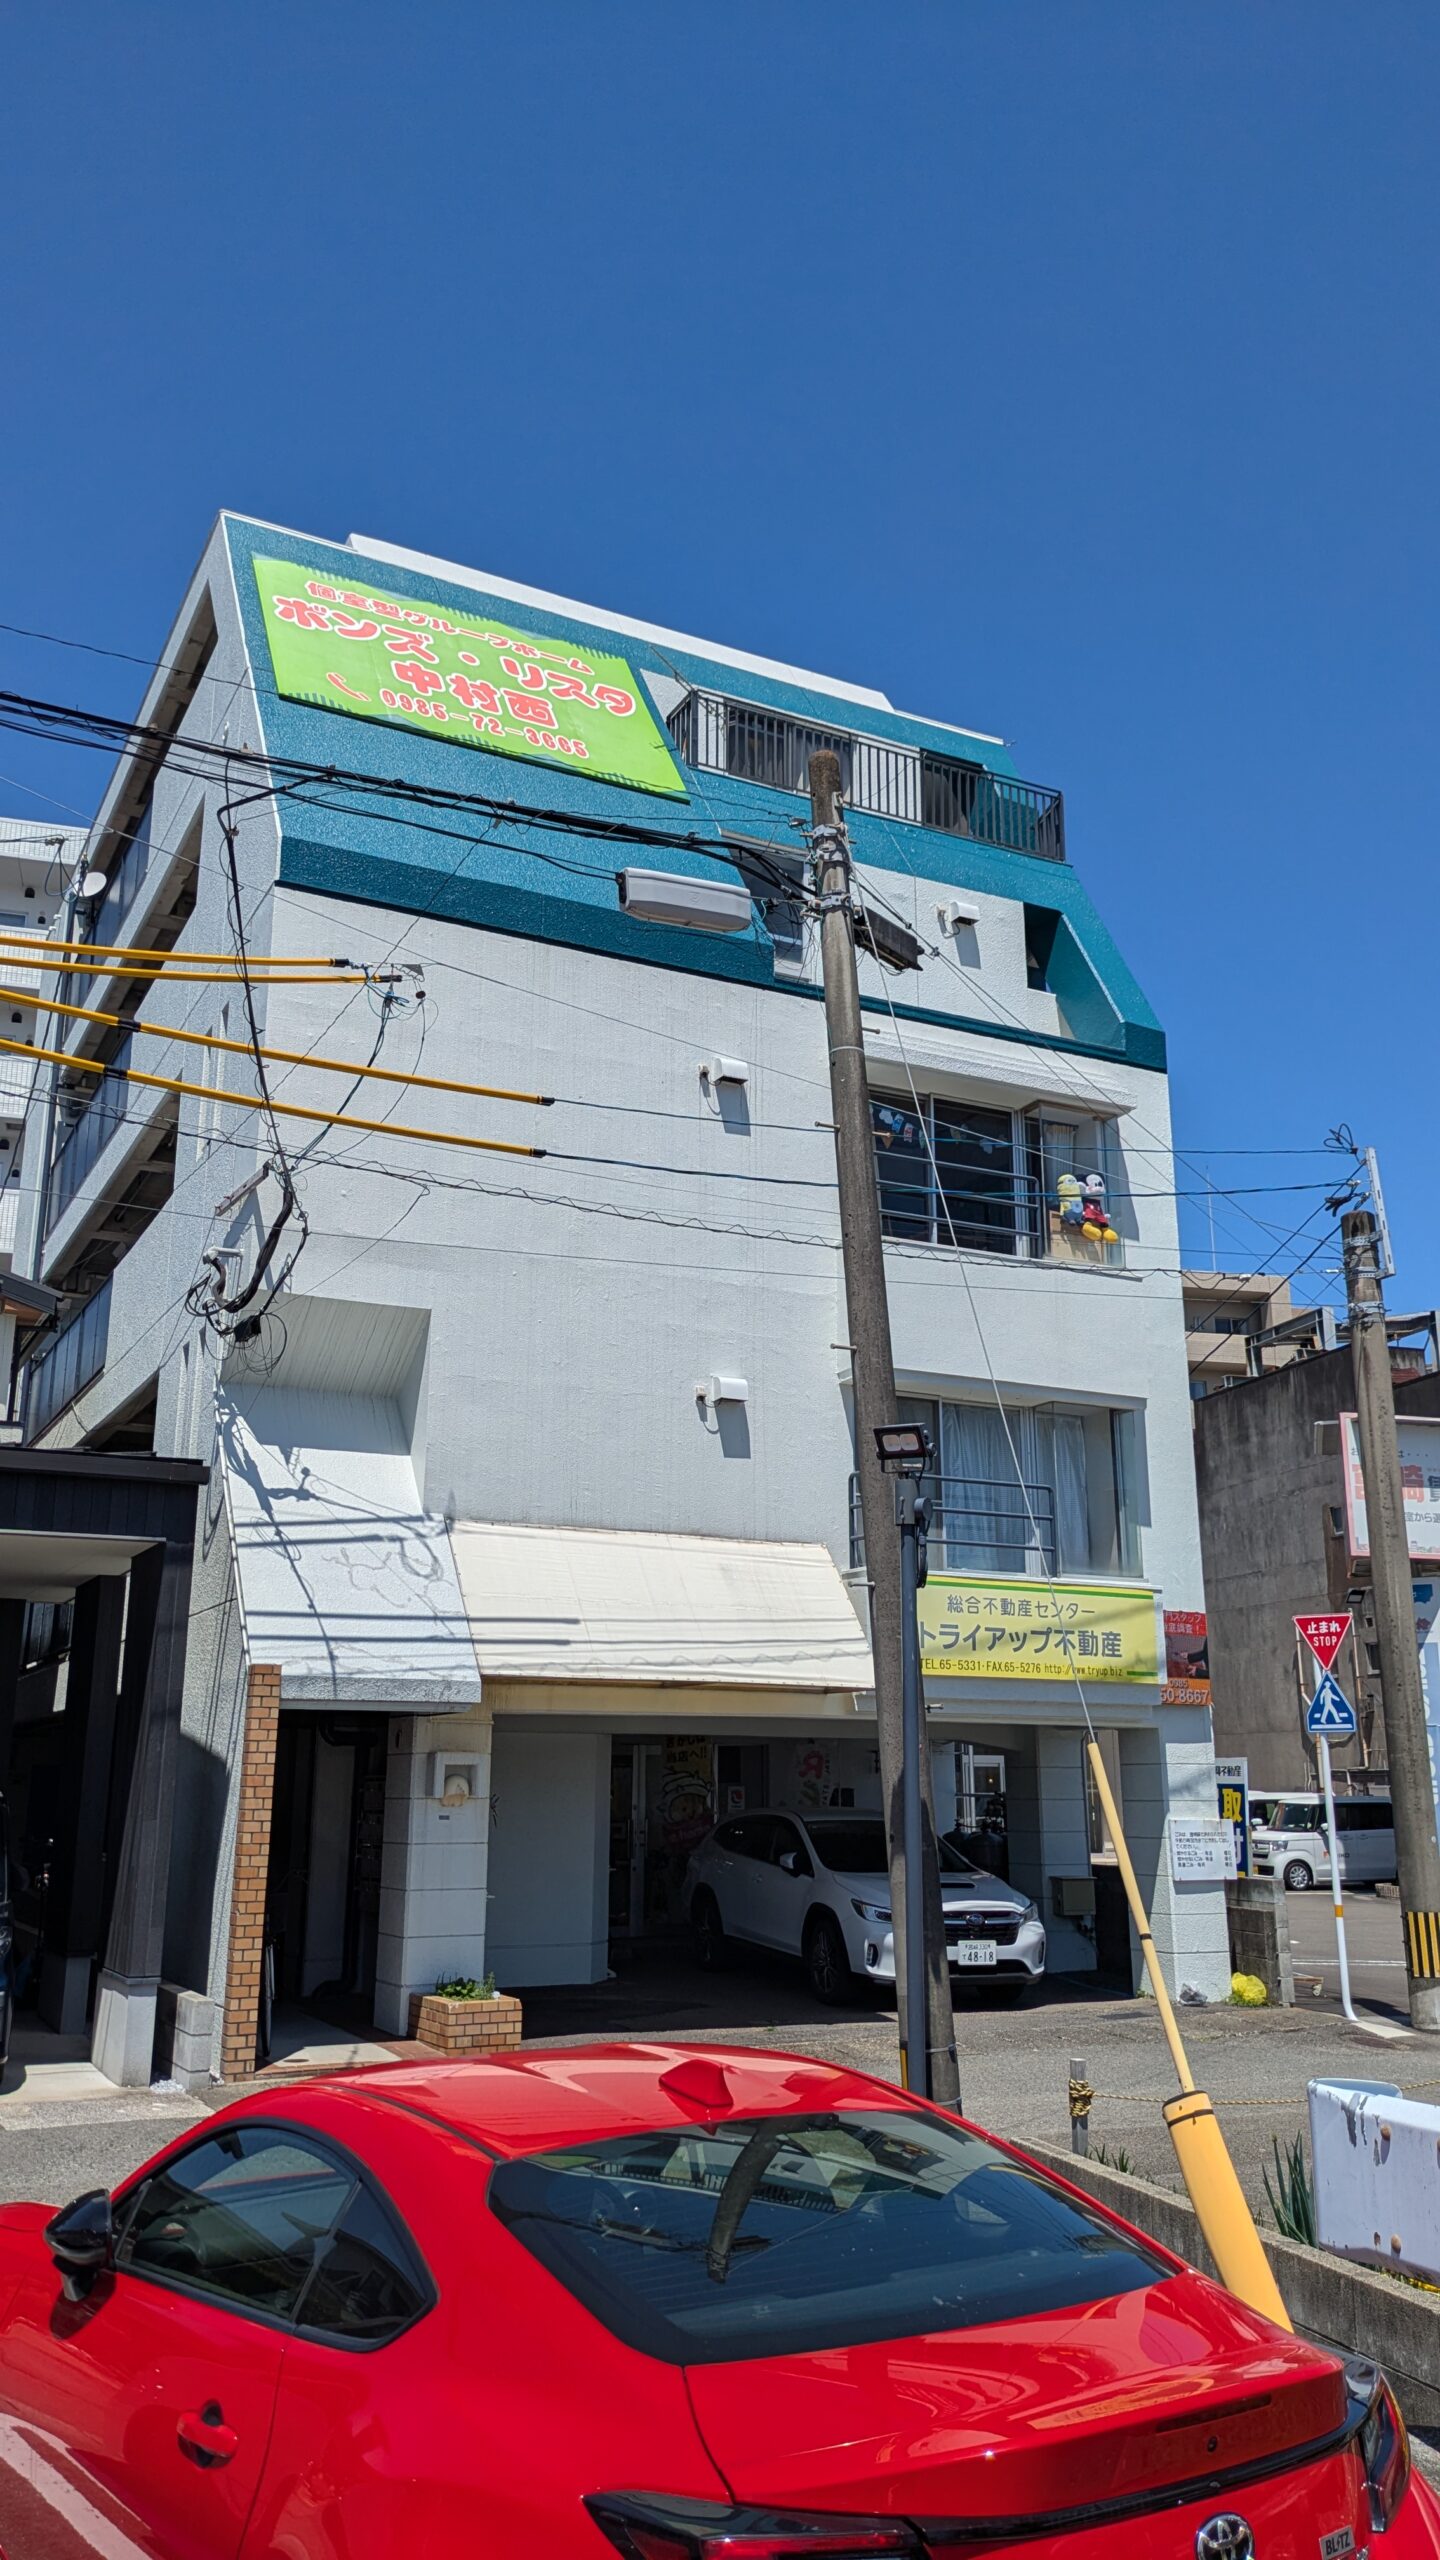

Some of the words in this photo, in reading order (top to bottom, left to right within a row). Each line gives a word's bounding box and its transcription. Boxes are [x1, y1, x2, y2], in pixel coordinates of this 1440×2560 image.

[305, 581, 595, 675] 個室型グループホーム
[273, 596, 636, 717] ボンズ・リスタ
[391, 660, 559, 729] 中村西
[947, 1594, 1096, 1620] 総合不動産センター
[919, 1621, 1123, 1658] トライアップ不動産
[1307, 1620, 1341, 1634] 止まれ
[1313, 1635, 1337, 1647] STOP
[967, 1951, 994, 1962] 48-18
